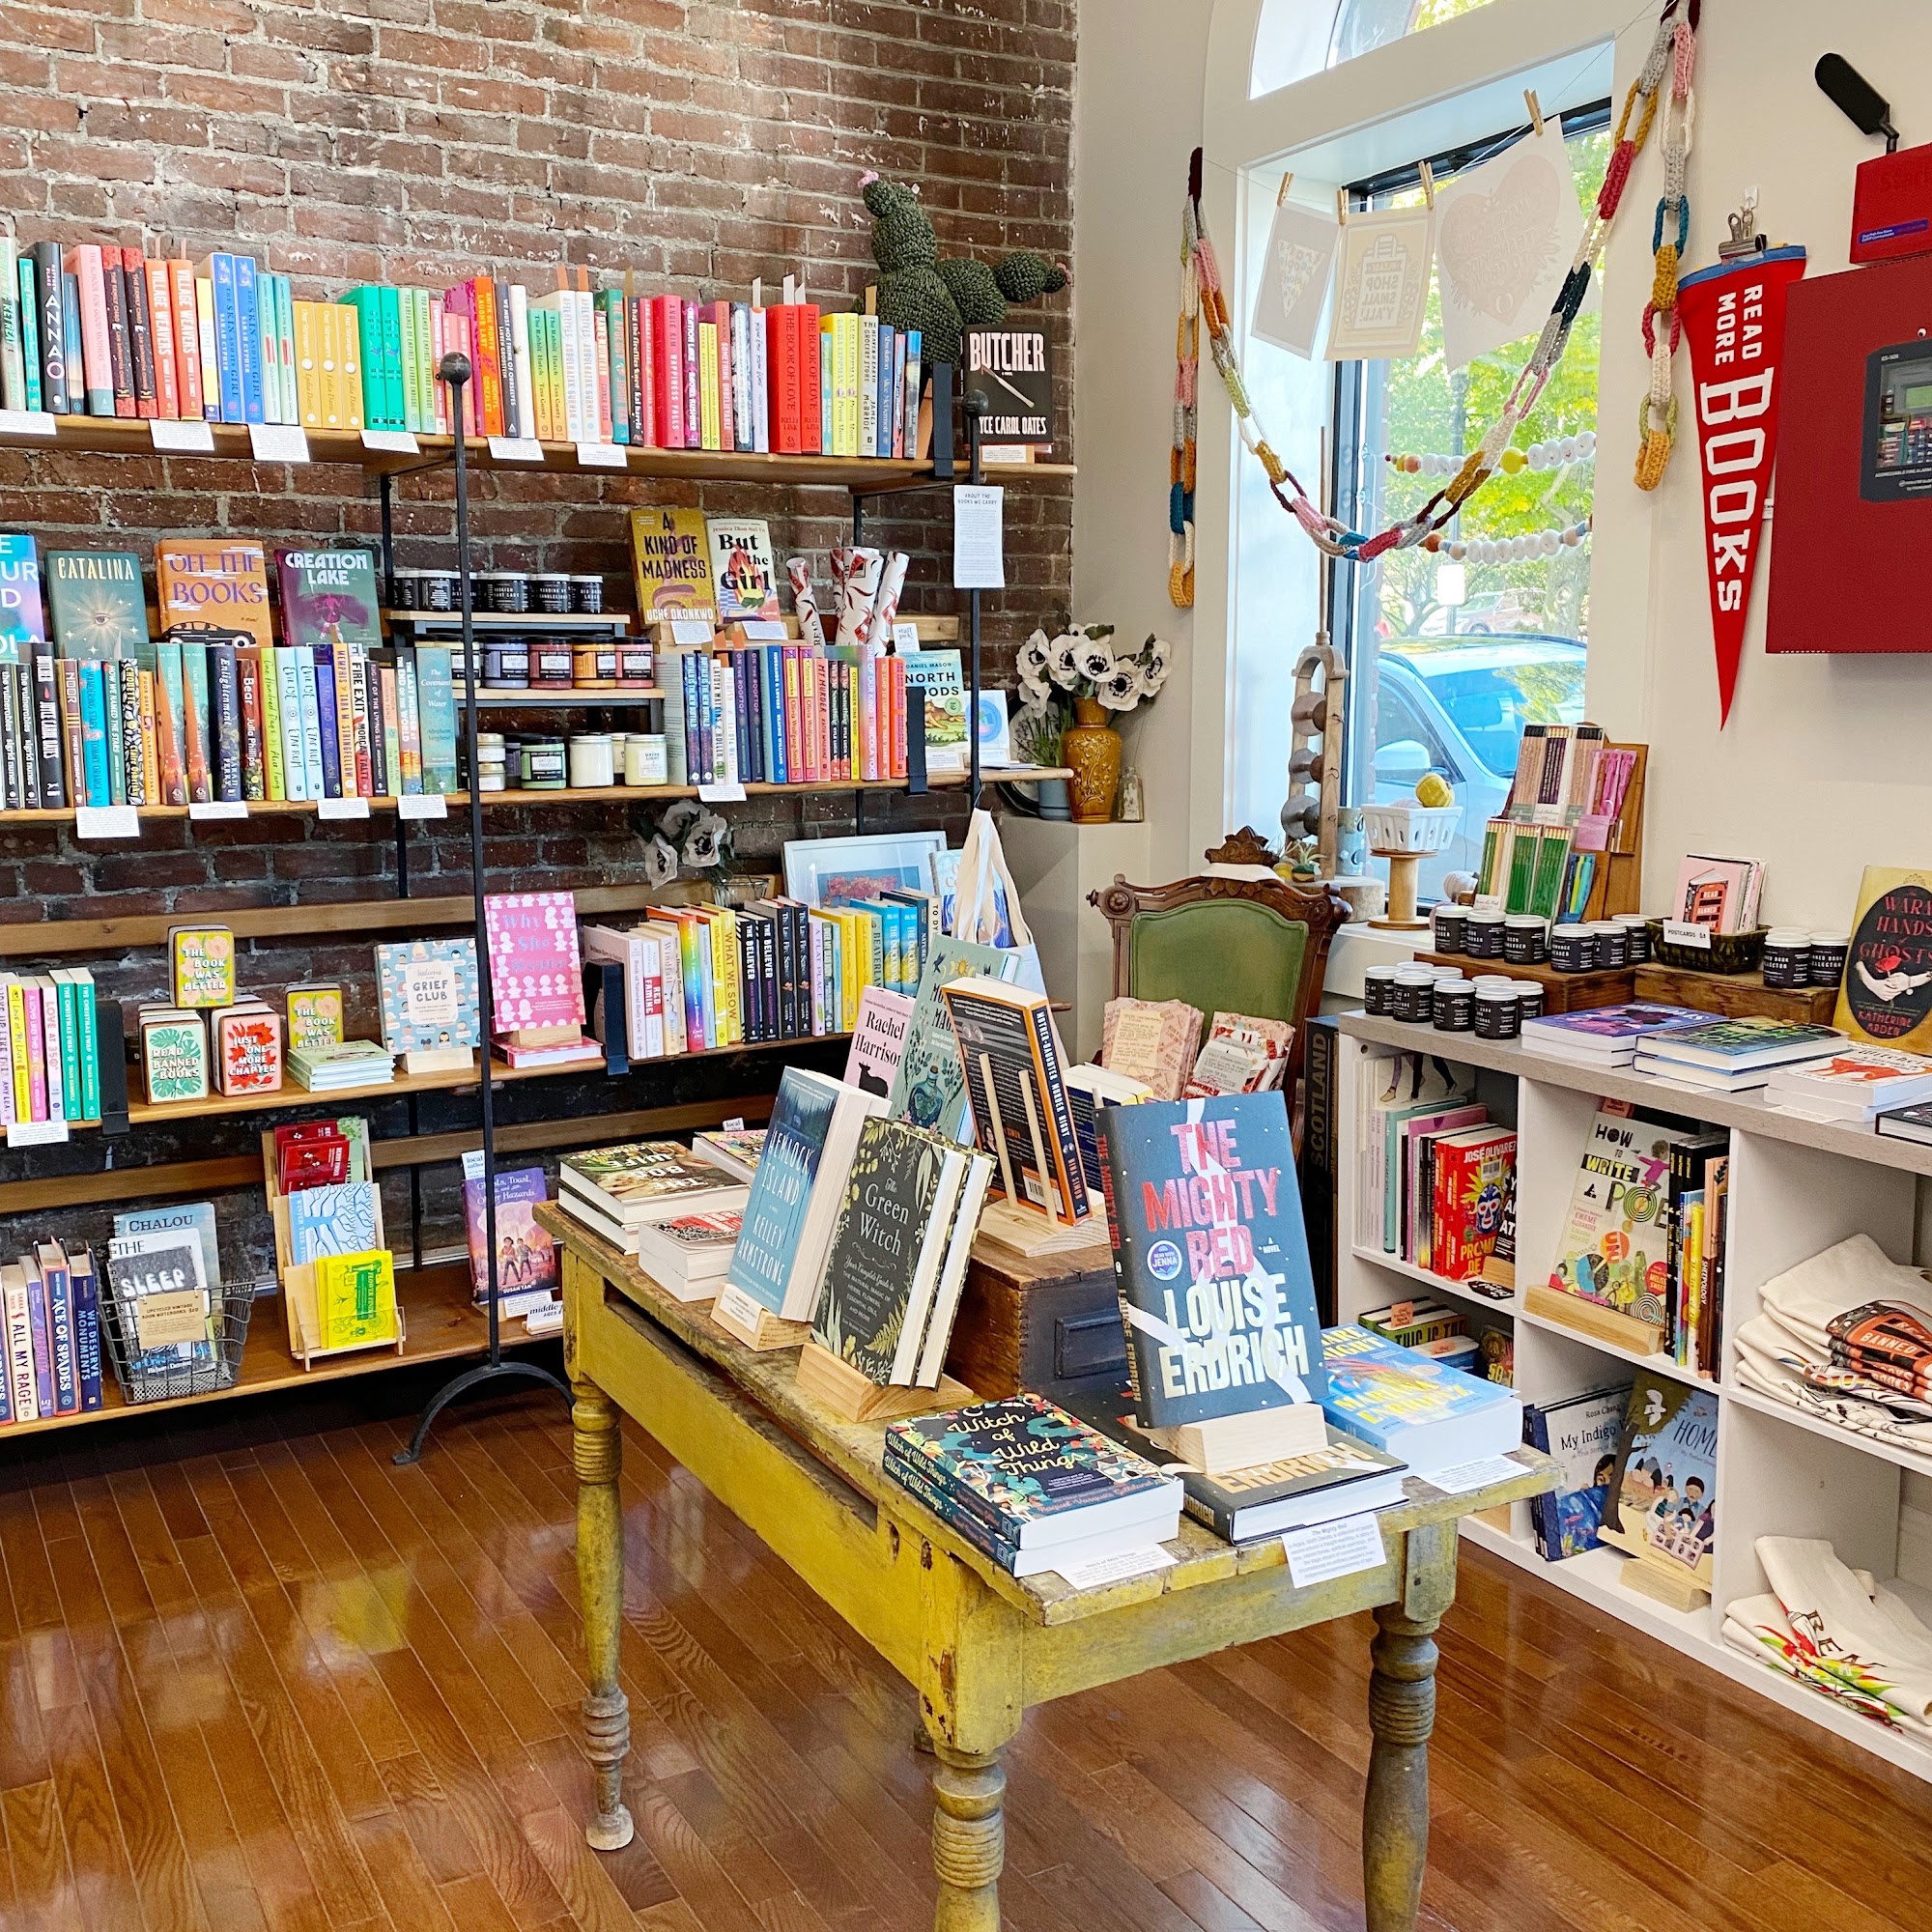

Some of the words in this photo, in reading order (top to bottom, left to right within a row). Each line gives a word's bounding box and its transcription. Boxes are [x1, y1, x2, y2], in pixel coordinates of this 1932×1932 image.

[152, 270, 168, 308] VILLAGE
[177, 270, 193, 307] VILLAGE
[45, 295, 64, 358] ANNA
[182, 308, 197, 355] WEAVERS
[785, 312, 795, 330] THE
[808, 312, 817, 331] THE
[1715, 293, 1737, 366] MORE
[1742, 284, 1763, 360] READ
[155, 311, 172, 355] WEAVERS
[785, 333, 795, 364] BOOK
[808, 333, 817, 364] BOOK
[969, 332, 1045, 374] BUTCHER
[46, 361, 65, 381] O
[669, 355, 678, 401] HAPPINESS
[786, 367, 796, 383] OF
[809, 367, 818, 383] OF
[786, 384, 796, 412] LOVE
[809, 384, 818, 412] LOVE
[979, 416, 992, 434] YCE
[995, 415, 1019, 435] CAROL
[1022, 416, 1046, 435] OATES
[1700, 366, 1775, 611] BOOKS
[663, 512, 670, 530] A
[644, 536, 676, 554] KIND
[683, 536, 697, 554] OF
[719, 533, 759, 551] But
[58, 557, 134, 581] CATALINA
[169, 554, 210, 573] OFF
[221, 554, 261, 572] THE
[285, 553, 368, 569] CREATION
[642, 560, 707, 580] MADNESS
[748, 554, 769, 566] the
[307, 569, 350, 585] LAKE
[721, 570, 771, 591] Girl
[173, 582, 263, 604] BOOKS
[646, 608, 668, 620] UCHE
[671, 608, 714, 620] OKONKWO
[36, 656, 54, 682] BUTCHER
[337, 650, 348, 683] MEMPHIS
[352, 662, 363, 686] FIRE
[905, 671, 955, 684] NORTH
[66, 672, 77, 703] NOOR
[109, 683, 117, 695] WE
[219, 658, 232, 725] Enlightenment
[243, 677, 254, 705] Bear
[434, 689, 441, 697] of
[923, 686, 960, 697] ODS
[40, 701, 56, 719] JOYCE
[354, 688, 365, 713] EXIT
[41, 719, 57, 739] CAROL
[246, 717, 256, 736] Julia
[43, 740, 58, 759] OATES
[247, 738, 257, 766] Phillips
[501, 913, 540, 930] Why
[184, 949, 206, 957] THE
[517, 936, 552, 952] She
[724, 932, 734, 967] WHAT
[194, 959, 226, 969] BOOK
[746, 941, 755, 980] BELIEVER
[184, 981, 227, 991] BETTER
[195, 971, 220, 980] WAS
[413, 980, 448, 991] GRIEF
[726, 970, 735, 988] WE
[416, 992, 447, 1002] CLUB
[644, 980, 653, 1014] FAMINE
[728, 992, 737, 1019] SOW
[296, 1008, 316, 1016] THE
[305, 1017, 335, 1027] BOOK
[1858, 1010, 1913, 1028] KATHERINE
[306, 1029, 330, 1037] WAS
[866, 1009, 905, 1040] Rachel
[1866, 1023, 1901, 1037] ARDEN
[234, 1036, 258, 1045] JUST
[246, 1046, 267, 1055] ONE
[297, 1038, 336, 1048] BETTER
[153, 1047, 184, 1058] READ
[153, 1057, 199, 1069] BANNED
[238, 1056, 267, 1065] MORE
[159, 1070, 200, 1081] BOOKS
[229, 1065, 276, 1076] CHAPTER
[1051, 1083, 1062, 1113] MURDER
[1057, 1115, 1070, 1138] NIGHT
[1310, 1033, 1327, 1168] SCOTLAND
[725, 1120, 741, 1128] local
[1096, 1133, 1109, 1160] THE
[1170, 1119, 1242, 1174] THE
[1595, 1123, 1634, 1149] HOW
[607, 1152, 676, 1169] WIFE
[769, 1128, 814, 1177] HEMLOCK
[1463, 1147, 1485, 1164] JOSÉ
[1485, 1141, 1517, 1159] OLIVAREZ
[1614, 1149, 1624, 1158] TO
[1585, 1155, 1634, 1182] WRITE
[651, 1176, 709, 1191] THE
[761, 1162, 800, 1207] ISLAND
[884, 1178, 897, 1194] The
[1099, 1165, 1118, 1218] MIGHTY
[865, 1182, 909, 1226] Green
[1141, 1167, 1278, 1233] MIGHTY
[1584, 1183, 1597, 1200] A
[1605, 1180, 1668, 1230] POE
[128, 1214, 193, 1232] CHALOU
[296, 1199, 304, 1225] WINTER
[1575, 1211, 1597, 1225] KWAME
[753, 1213, 784, 1251] KELLEY
[860, 1210, 901, 1257] Witch
[1109, 1222, 1121, 1250] RED
[1571, 1219, 1597, 1232] ALEXANDER
[116, 1240, 145, 1256] THE
[299, 1246, 308, 1264] FIND
[1185, 1224, 1255, 1282] RED
[1263, 1243, 1282, 1254] NOVEL
[737, 1236, 785, 1287] ARMSTRONG
[1151, 1256, 1178, 1267] JENNA
[120, 1267, 185, 1297] SLEEP
[367, 1271, 376, 1295] FLOWER
[1700, 1259, 1709, 1306] SHEEPOLOGY
[51, 1298, 67, 1323] ACE
[156, 1309, 186, 1318] NOTEBOOKS
[367, 1296, 376, 1319] FINDER
[529, 1304, 557, 1315] middle
[1119, 1288, 1133, 1339] LOUISE
[1163, 1273, 1292, 1340] LOUISE
[87, 1310, 96, 1326] WE
[13, 1324, 26, 1346] ALL
[55, 1324, 68, 1341] OF
[1860, 1330, 1919, 1355] BANNED
[77, 1310, 91, 1380] MONUMENTS
[89, 1331, 99, 1378] DESERVE
[14, 1350, 28, 1367] MY
[56, 1344, 71, 1391] SPADES
[1158, 1324, 1310, 1400] ERDRICH
[1125, 1344, 1142, 1403] ERDRICH
[16, 1374, 31, 1406] RAGE
[1585, 1409, 1600, 1419] Rosa
[1601, 1404, 1621, 1417] Chang
[947, 1411, 1026, 1435] Witch
[991, 1427, 1016, 1442] of
[1560, 1435, 1579, 1451] My
[1581, 1424, 1616, 1444] Indigo
[991, 1437, 1063, 1463] Wild
[998, 1451, 1089, 1476] Things
[1210, 1441, 1375, 1494] ERDRICH
[884, 1455, 901, 1479] Witch
[900, 1470, 909, 1487] of
[908, 1473, 924, 1494] Wild
[923, 1486, 944, 1511] Things
